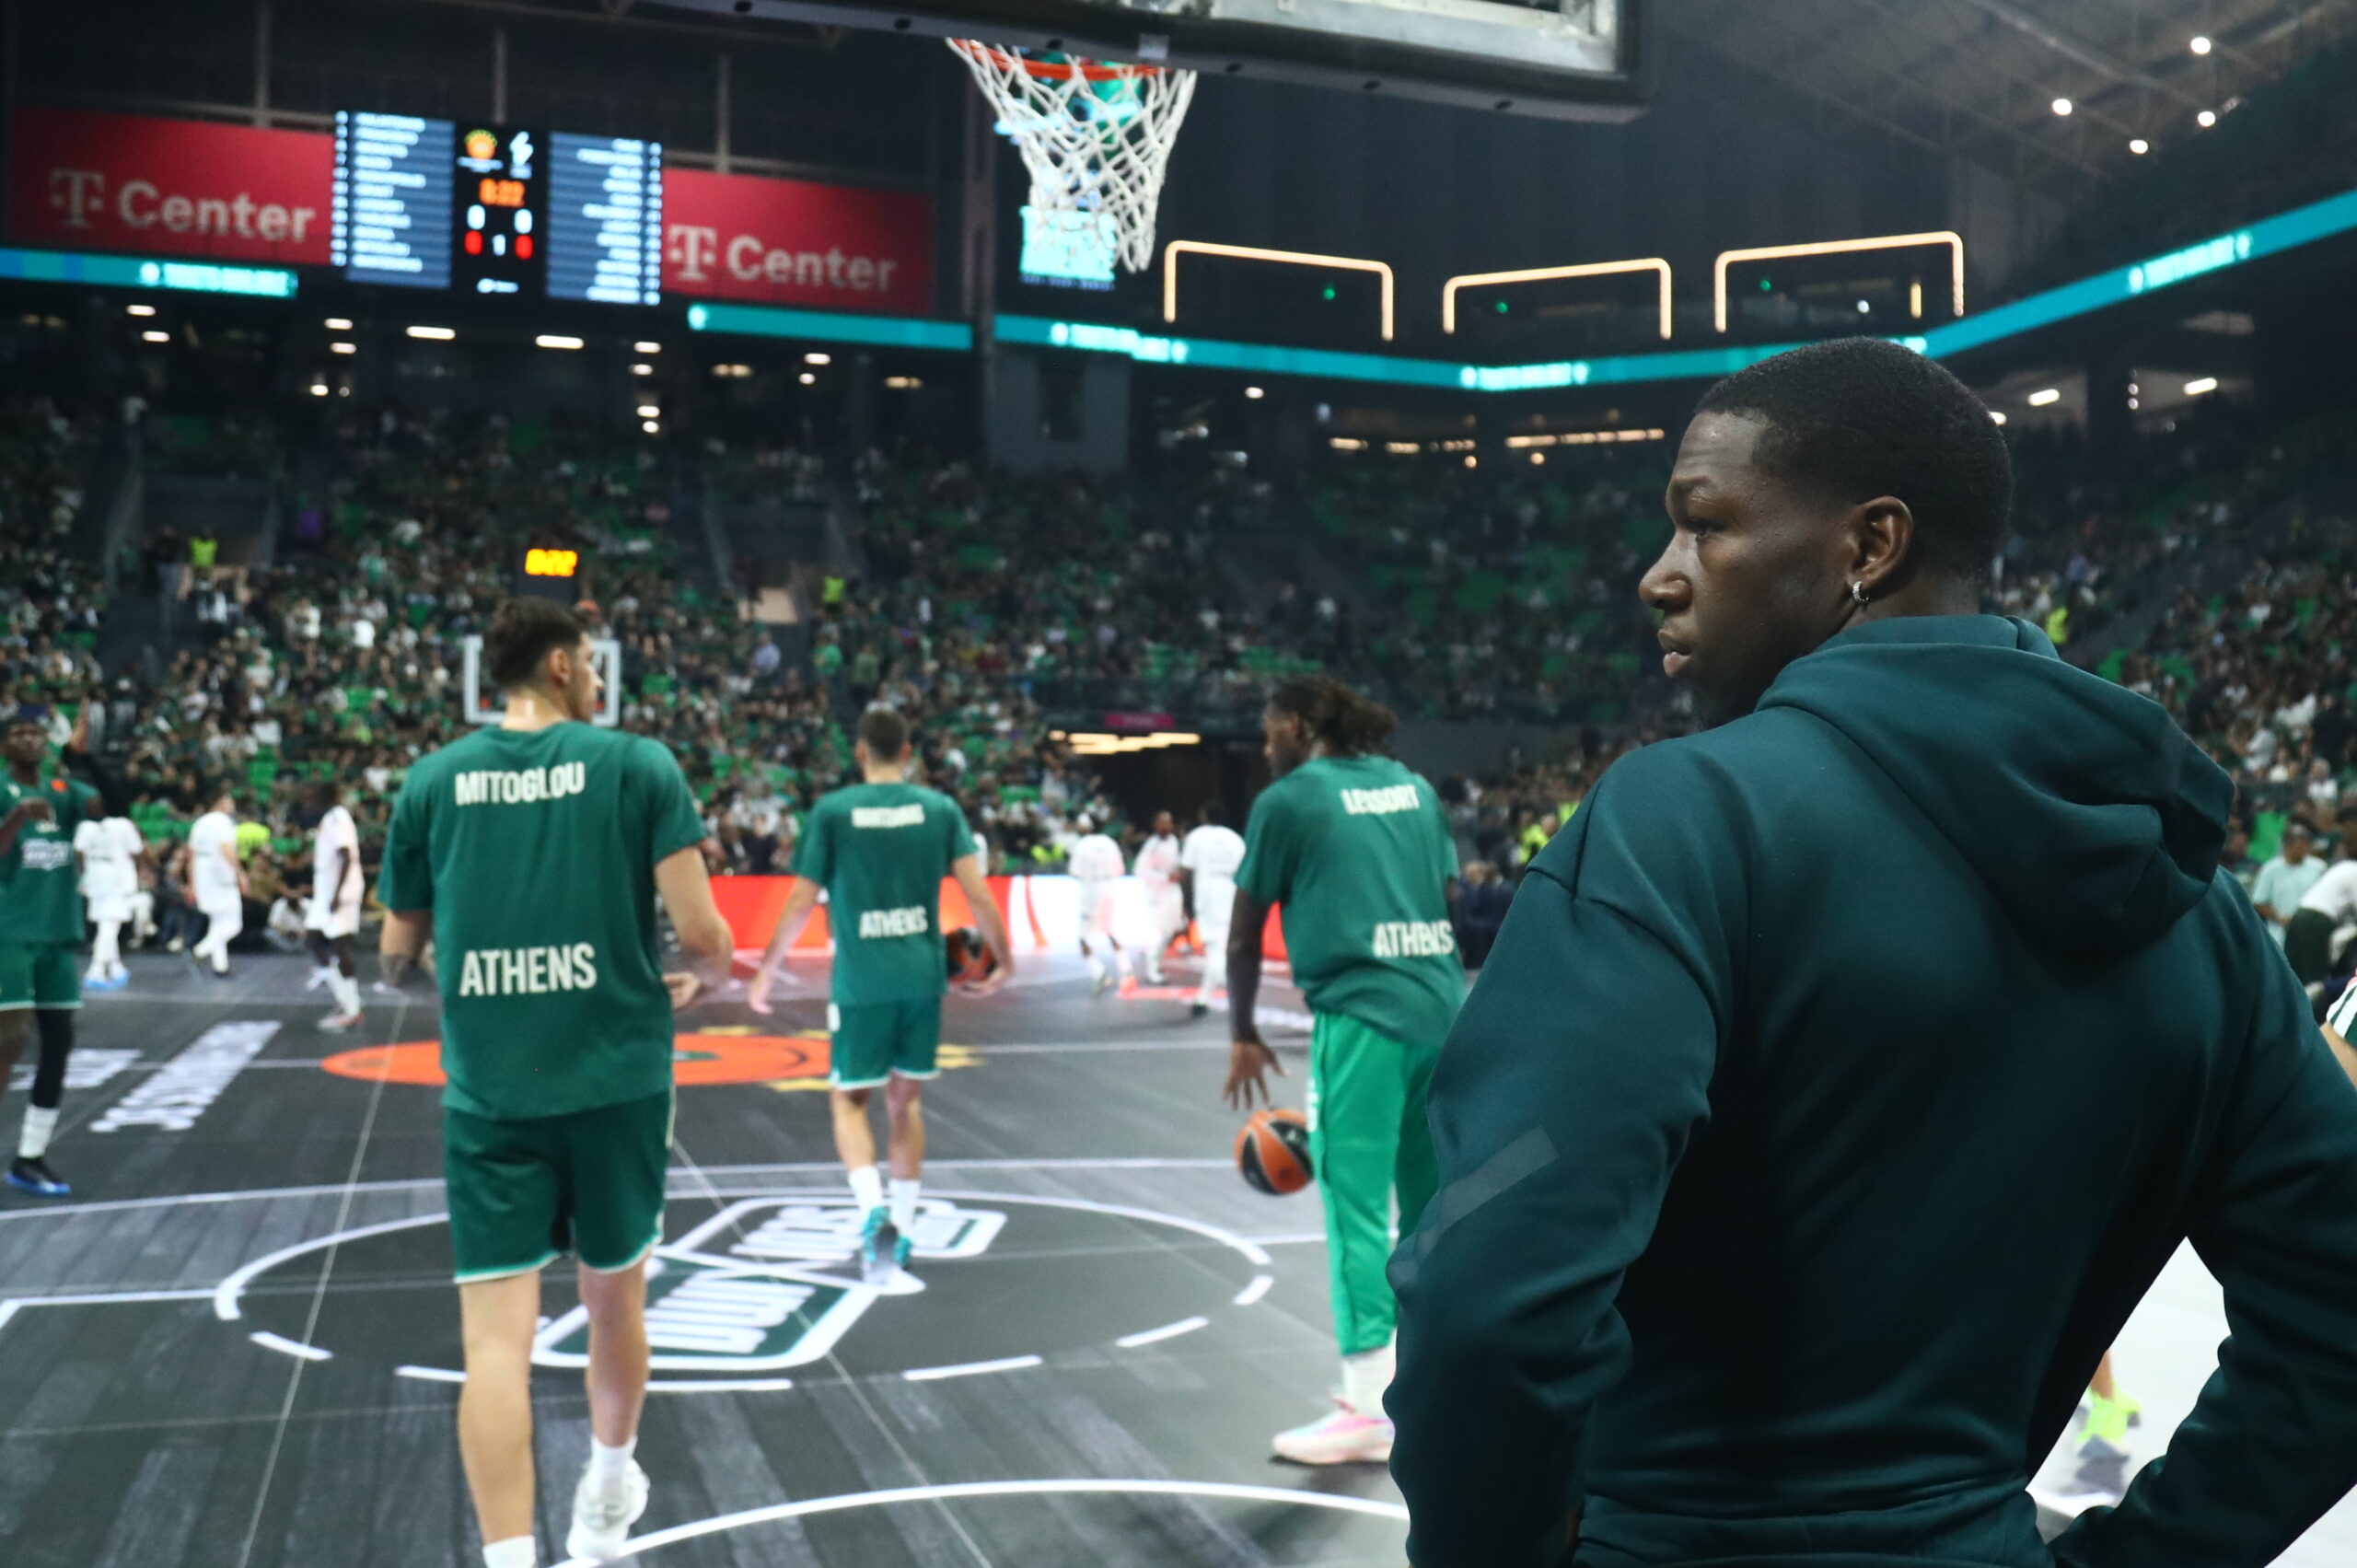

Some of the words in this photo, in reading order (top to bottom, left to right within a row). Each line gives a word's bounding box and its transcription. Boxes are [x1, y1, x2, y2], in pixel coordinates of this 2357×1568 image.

[118, 180, 316, 242] Center
[726, 234, 898, 292] Center
[455, 761, 586, 807] MITOGLOU
[858, 905, 928, 939] ATHENS
[1373, 920, 1455, 958] ATHENS
[459, 942, 598, 997] ATHENS
